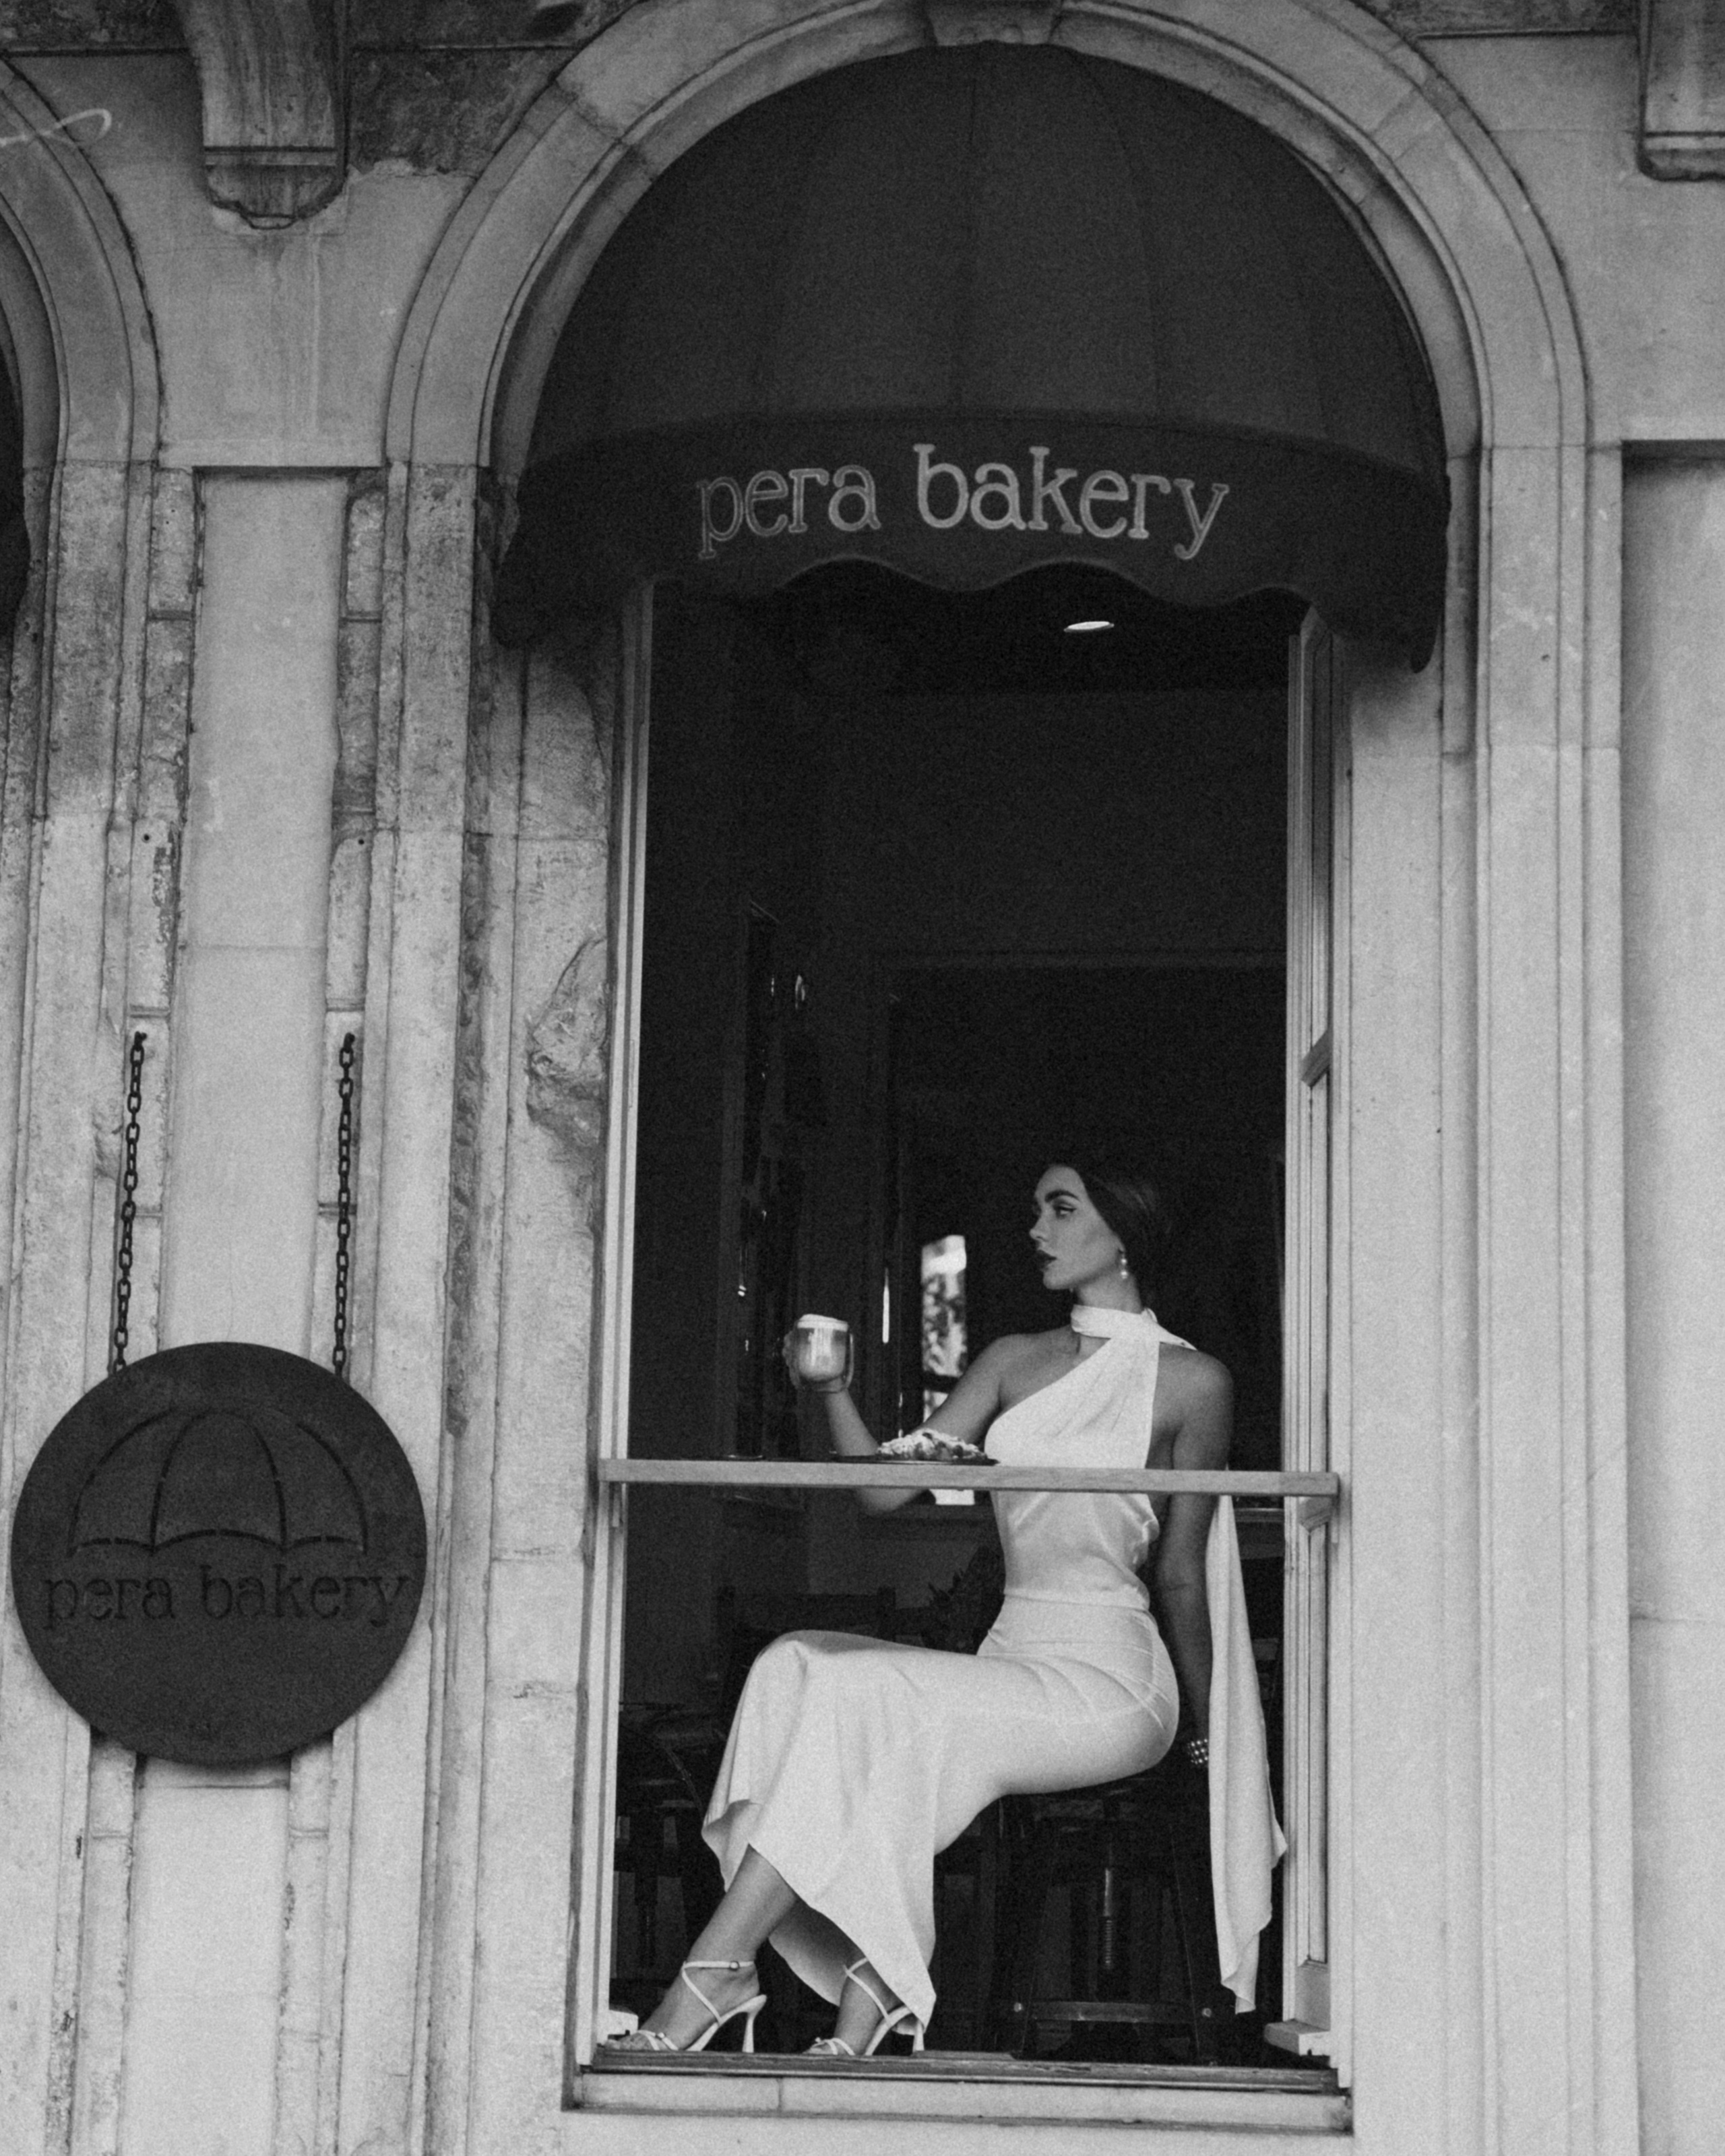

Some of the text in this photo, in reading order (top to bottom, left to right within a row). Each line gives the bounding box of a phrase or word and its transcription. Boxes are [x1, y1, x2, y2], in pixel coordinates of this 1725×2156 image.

[697, 443, 1230, 560] pera bakery
[41, 1563, 410, 1630] pera bakery
